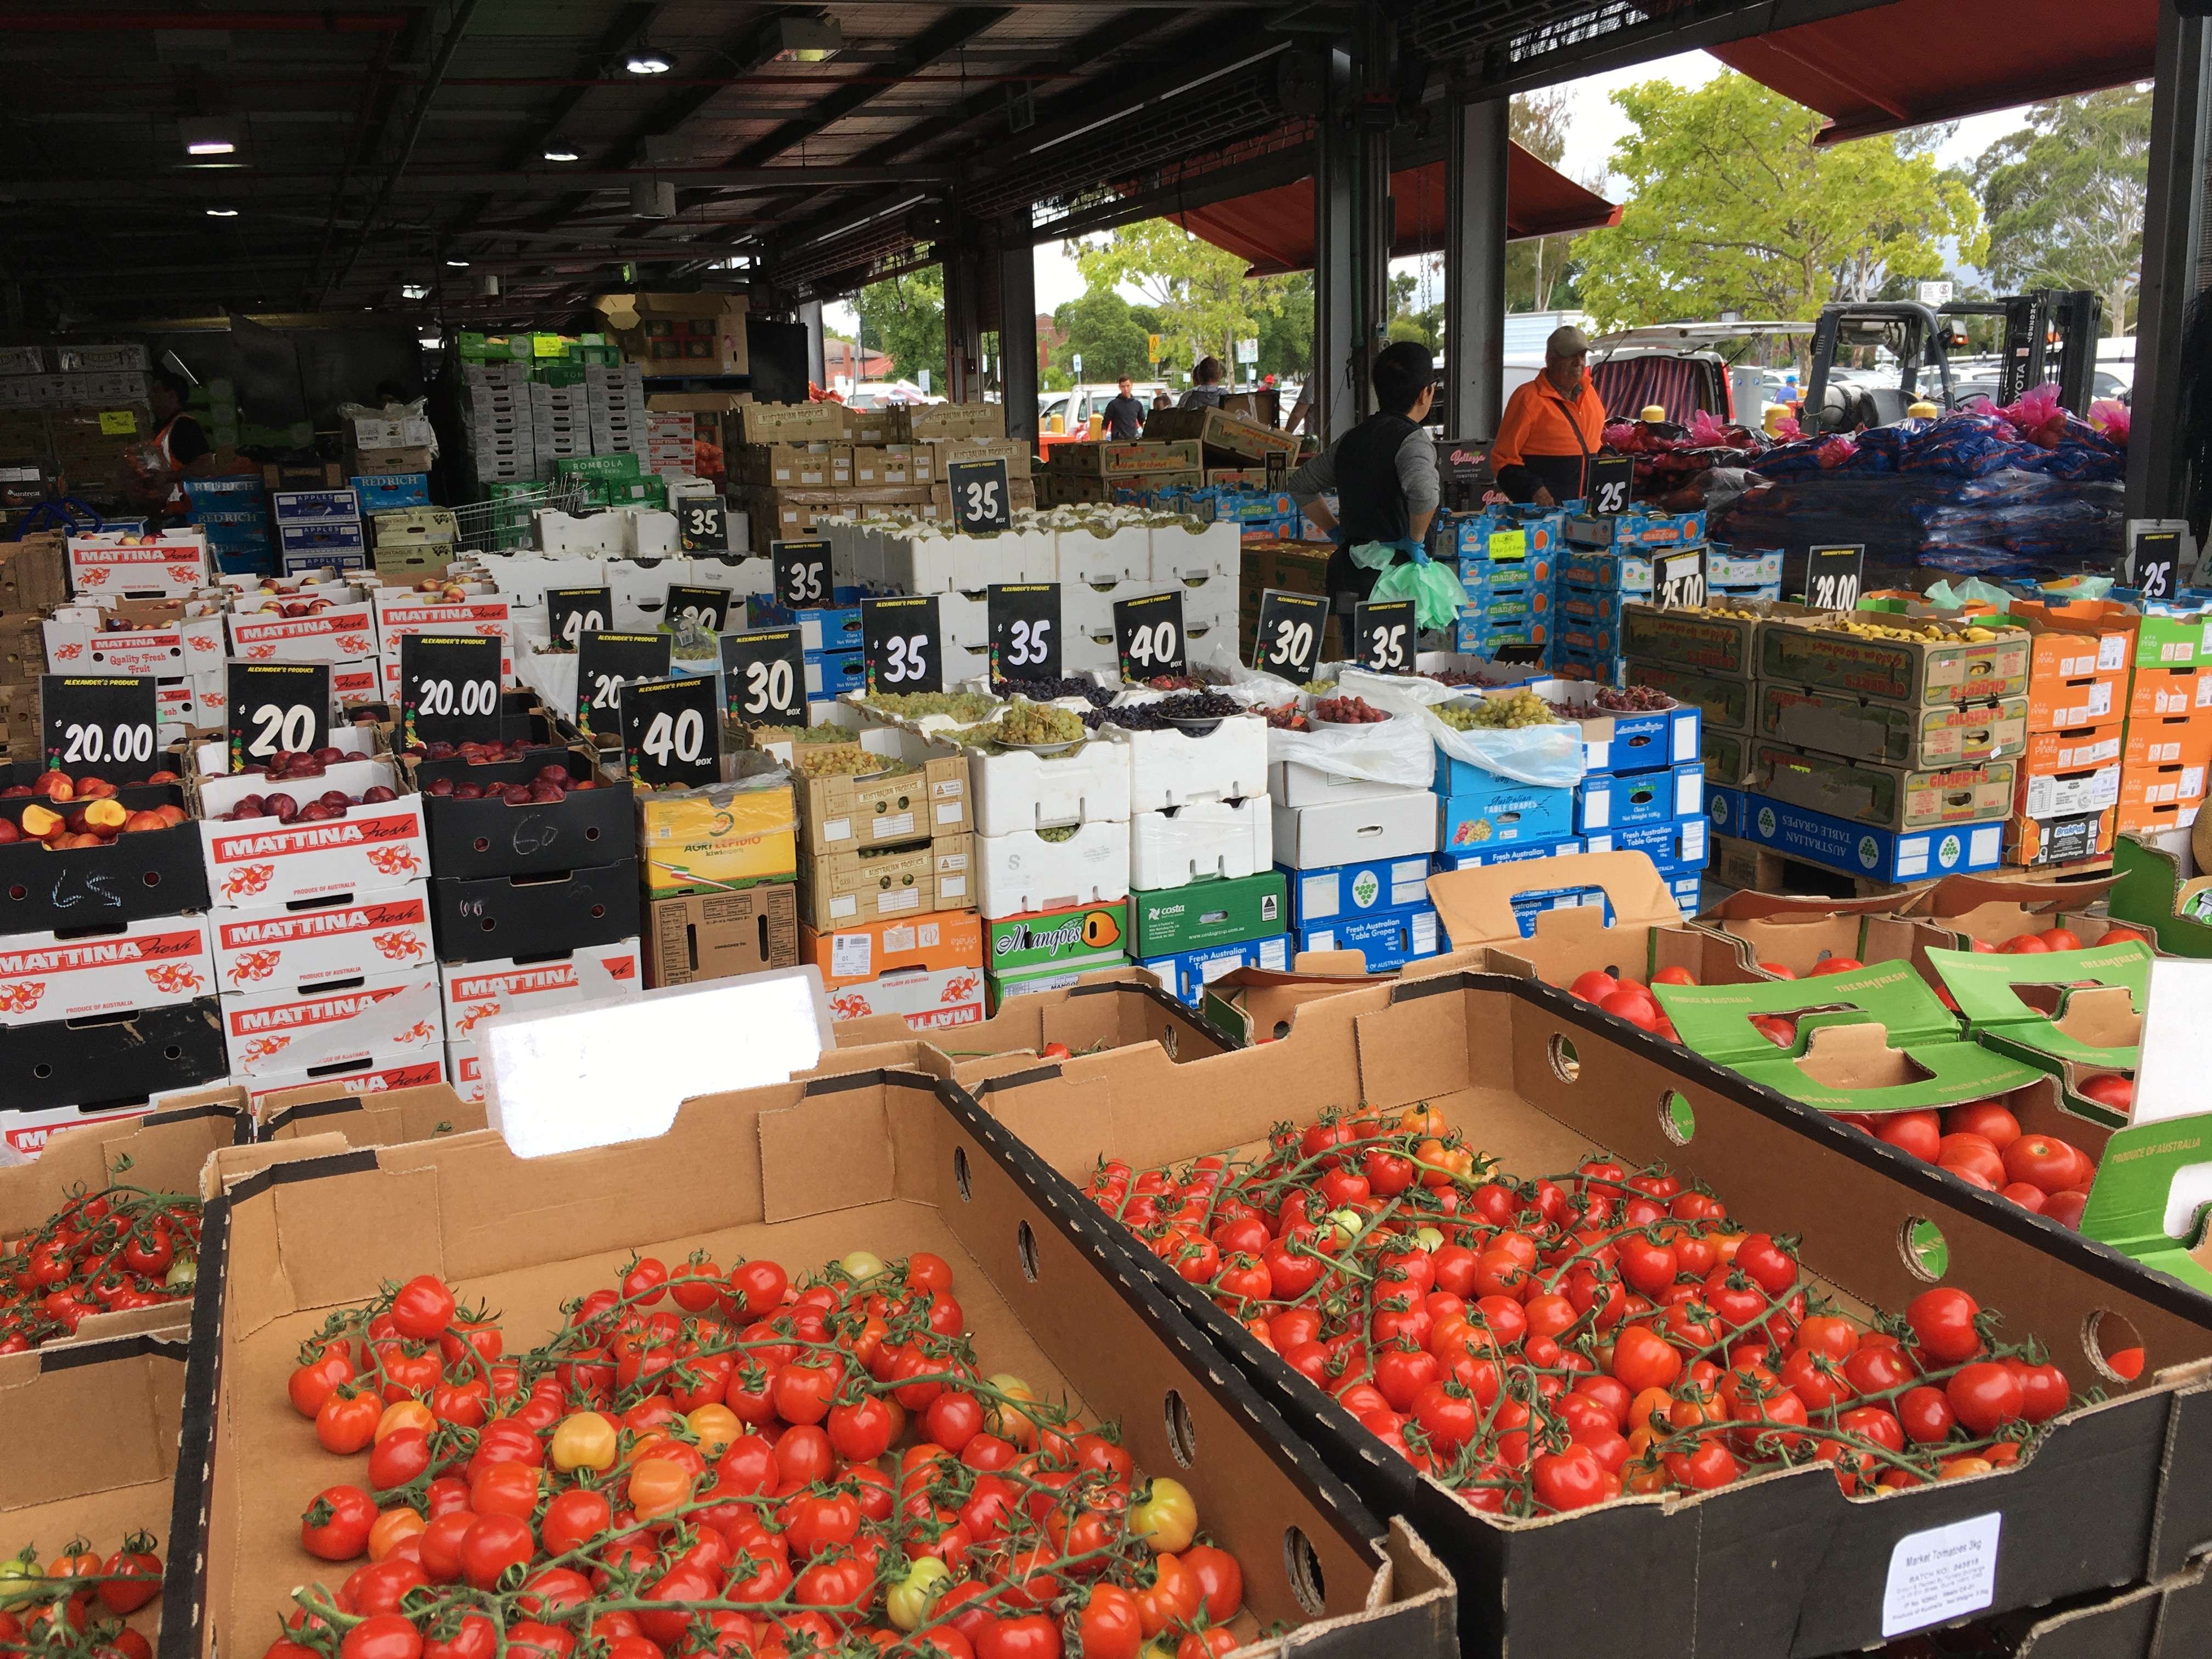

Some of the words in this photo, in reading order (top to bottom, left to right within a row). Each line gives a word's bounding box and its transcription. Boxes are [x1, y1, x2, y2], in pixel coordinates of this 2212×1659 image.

[762, 412, 797, 422] AUSTRALIAN
[798, 408, 829, 419] PRODUCE
[953, 450, 986, 459] AUSTRALIAN
[988, 447, 1013, 456] PRODUCE
[573, 460, 623, 470] ROMBOLA
[967, 481, 999, 522] 35
[1598, 482, 1626, 512] 25
[690, 509, 719, 535] 35
[81, 550, 165, 563] MATTINA
[164, 549, 195, 561] Fresh
[789, 562, 823, 601] 35
[2142, 562, 2170, 597] 25
[1127, 598, 1153, 607] ALEXANDER'S
[389, 608, 475, 622] MATTINA
[473, 607, 503, 619] Fresh
[242, 620, 333, 640] MATTINA
[331, 617, 365, 631] Fresh
[562, 610, 604, 645] 40
[96, 639, 156, 648] MATTINA
[1008, 620, 1051, 665] 35
[1130, 622, 1176, 667] 40
[1269, 620, 1313, 667] 30
[1369, 624, 1406, 670] 35
[110, 653, 139, 665] Quality
[142, 653, 166, 662] Fresh
[884, 635, 929, 683] 35
[1171, 660, 1182, 668] BOX
[128, 665, 150, 674] Fruit
[744, 659, 794, 714] 30
[1950, 680, 2006, 699] GILBERT'S
[419, 679, 496, 716] 20.00
[1946, 706, 2004, 727] GILBERT'S
[248, 704, 316, 757] 20
[642, 709, 704, 766] 40
[64, 723, 153, 763] 20.00
[695, 757, 712, 766] BOX
[1929, 769, 1988, 788] GILBERT'S
[863, 787, 894, 800] AUSTRALIAN
[895, 781, 918, 794] PRODUCE
[1488, 794, 1532, 806] Australian
[1484, 803, 1507, 814] TABLE
[1509, 801, 1537, 811] GRAPES
[513, 813, 558, 855] 60
[1641, 827, 1672, 838] Australian
[1782, 815, 1819, 834] GRAPES
[2056, 824, 2086, 836] BrakPak
[223, 825, 364, 859] MATTINA
[359, 820, 413, 840] Fresh
[715, 836, 761, 850] LEPIDIO
[1645, 836, 1667, 844] Grapes
[1785, 830, 1847, 856] AUSTRALIAN
[1825, 830, 1852, 844] TABLE
[1511, 848, 1544, 860] Australian
[868, 863, 899, 876] AUSTRALIAN
[900, 857, 924, 870] PRODUCE
[1161, 905, 1185, 915] costa
[230, 910, 370, 945] MATTINA
[365, 905, 419, 926] Fresh
[1346, 924, 1364, 934] Fresh
[1366, 919, 1400, 931] Australian
[1351, 932, 1370, 940] Table
[1372, 928, 1395, 937] Grapes
[995, 923, 1082, 956] Mangoes
[0, 941, 144, 975] MATTINA
[137, 936, 195, 957] Fresh
[1189, 954, 1208, 963] Fresh
[1210, 947, 1246, 959] Australian
[1378, 959, 1405, 968] AUSTRALIA
[299, 972, 324, 980] PRODUCE
[333, 967, 362, 975] AUSTRALIA
[1051, 981, 1076, 990] MANGO
[102, 1000, 133, 1008] AUSTRALIA
[240, 995, 377, 1032] MATTINA
[341, 1051, 370, 1060] AUSTRALIA
[2112, 1148, 2145, 1164] PRODUCE
[2146, 1146, 2156, 1156] OF
[2156, 1137, 2201, 1154] AUSTRALIA
[1906, 1553, 1930, 1567] Market
[1933, 1544, 1967, 1559] Tomatoes
[1968, 1541, 1982, 1550] 3kg
